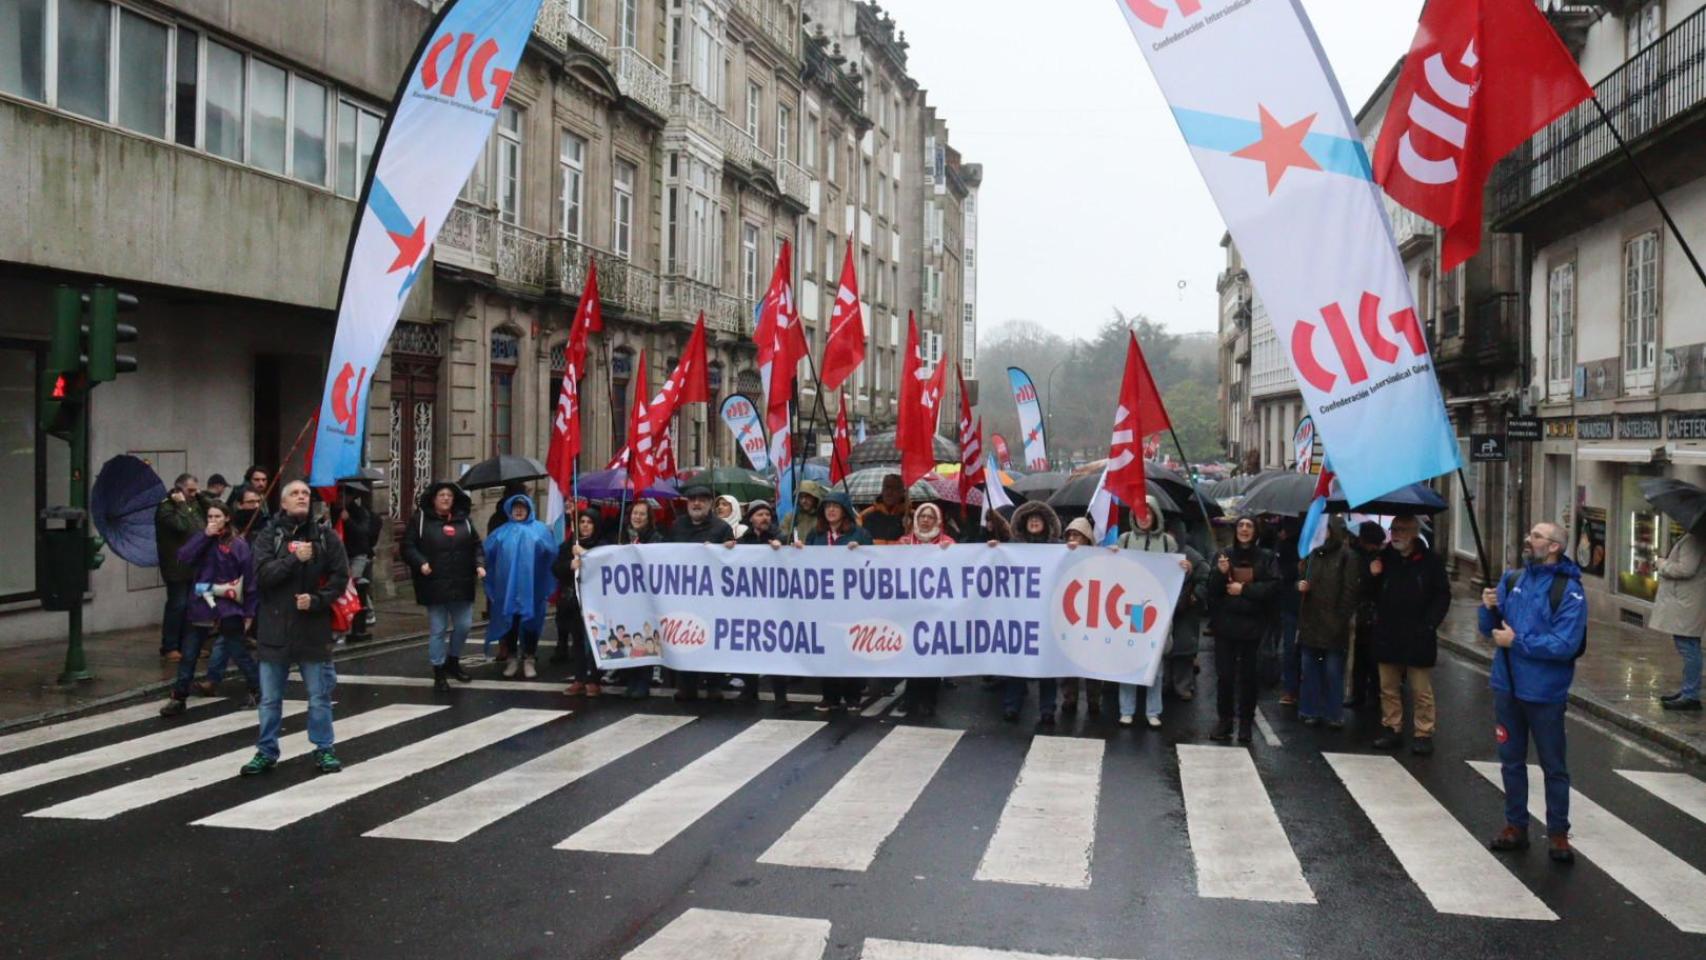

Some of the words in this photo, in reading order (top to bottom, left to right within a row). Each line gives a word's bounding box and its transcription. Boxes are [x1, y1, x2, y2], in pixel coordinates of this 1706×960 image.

[420, 32, 513, 110] CIG
[1291, 291, 1428, 394] CIG
[601, 563, 647, 596] POR
[649, 563, 714, 597] UNHA
[721, 565, 835, 600] SANIDADE
[843, 560, 953, 600] PÚBLICA
[961, 566, 1041, 599] FORTE
[1063, 578, 1158, 633] CIG
[660, 616, 706, 646] Máis
[714, 618, 825, 655] PERSOAL
[848, 623, 903, 653] Máis
[913, 619, 1040, 656] CALIDADE
